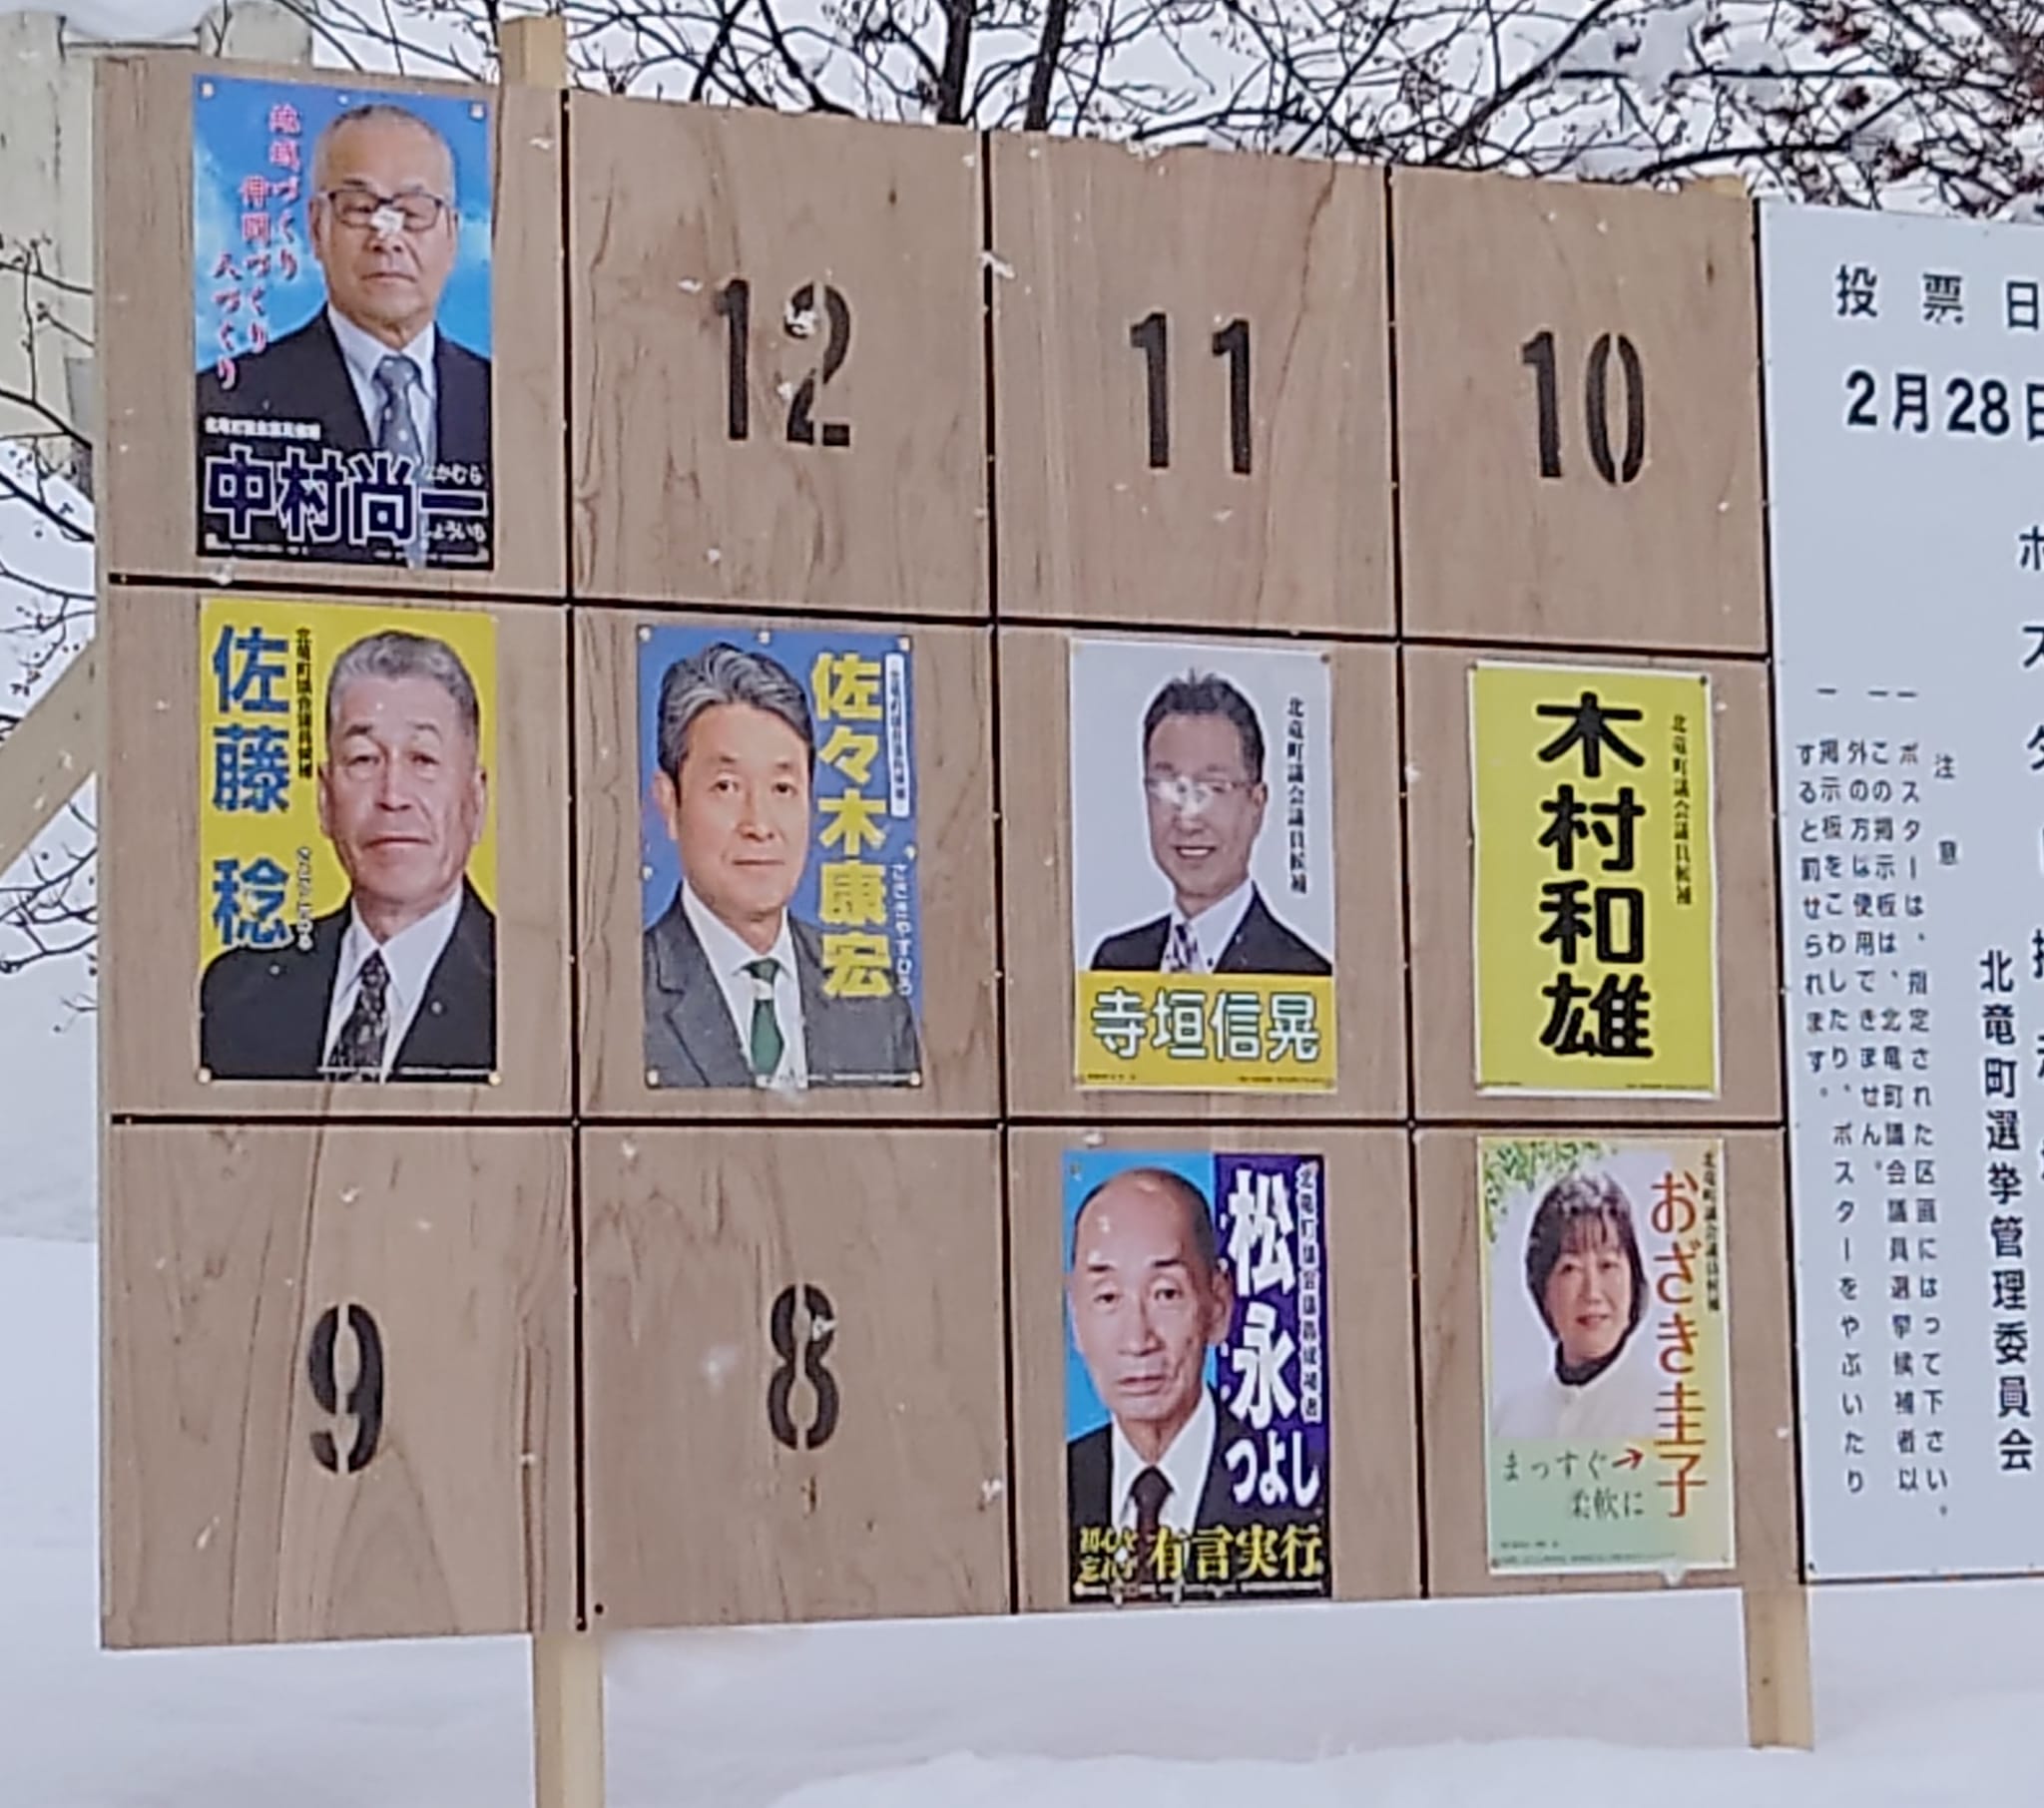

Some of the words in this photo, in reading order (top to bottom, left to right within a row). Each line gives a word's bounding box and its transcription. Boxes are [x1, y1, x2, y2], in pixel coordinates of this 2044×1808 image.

[241, 176, 272, 353] 仲間づくり
[268, 104, 300, 280] 地域づくり
[213, 251, 243, 390] 人づくり
[717, 279, 851, 447] 12
[1836, 264, 2039, 331] 投票日
[1130, 312, 1253, 476] 11
[1522, 330, 1646, 488] 10
[204, 443, 488, 545] 中村尚一
[212, 625, 290, 814] 佐藤
[810, 651, 893, 999] 佐々木康宏
[1536, 691, 1654, 1059] 木村和雄
[1934, 752, 1958, 866] 注意
[212, 856, 292, 948] 稔
[1093, 988, 1320, 1062] 寺垣信晃
[1979, 950, 2033, 1472] 北竜町選挙管理委員会
[766, 1283, 839, 1451] 8
[1227, 1166, 1296, 1430] 松永
[1651, 1170, 1708, 1519] おざき圭子
[308, 1303, 384, 1475] 9
[1226, 1429, 1320, 1509] つよし
[1504, 1449, 1608, 1482] まっすぐ
[1148, 1523, 1323, 1582] 有言実行
[1572, 1487, 1645, 1520] 柔軟に
